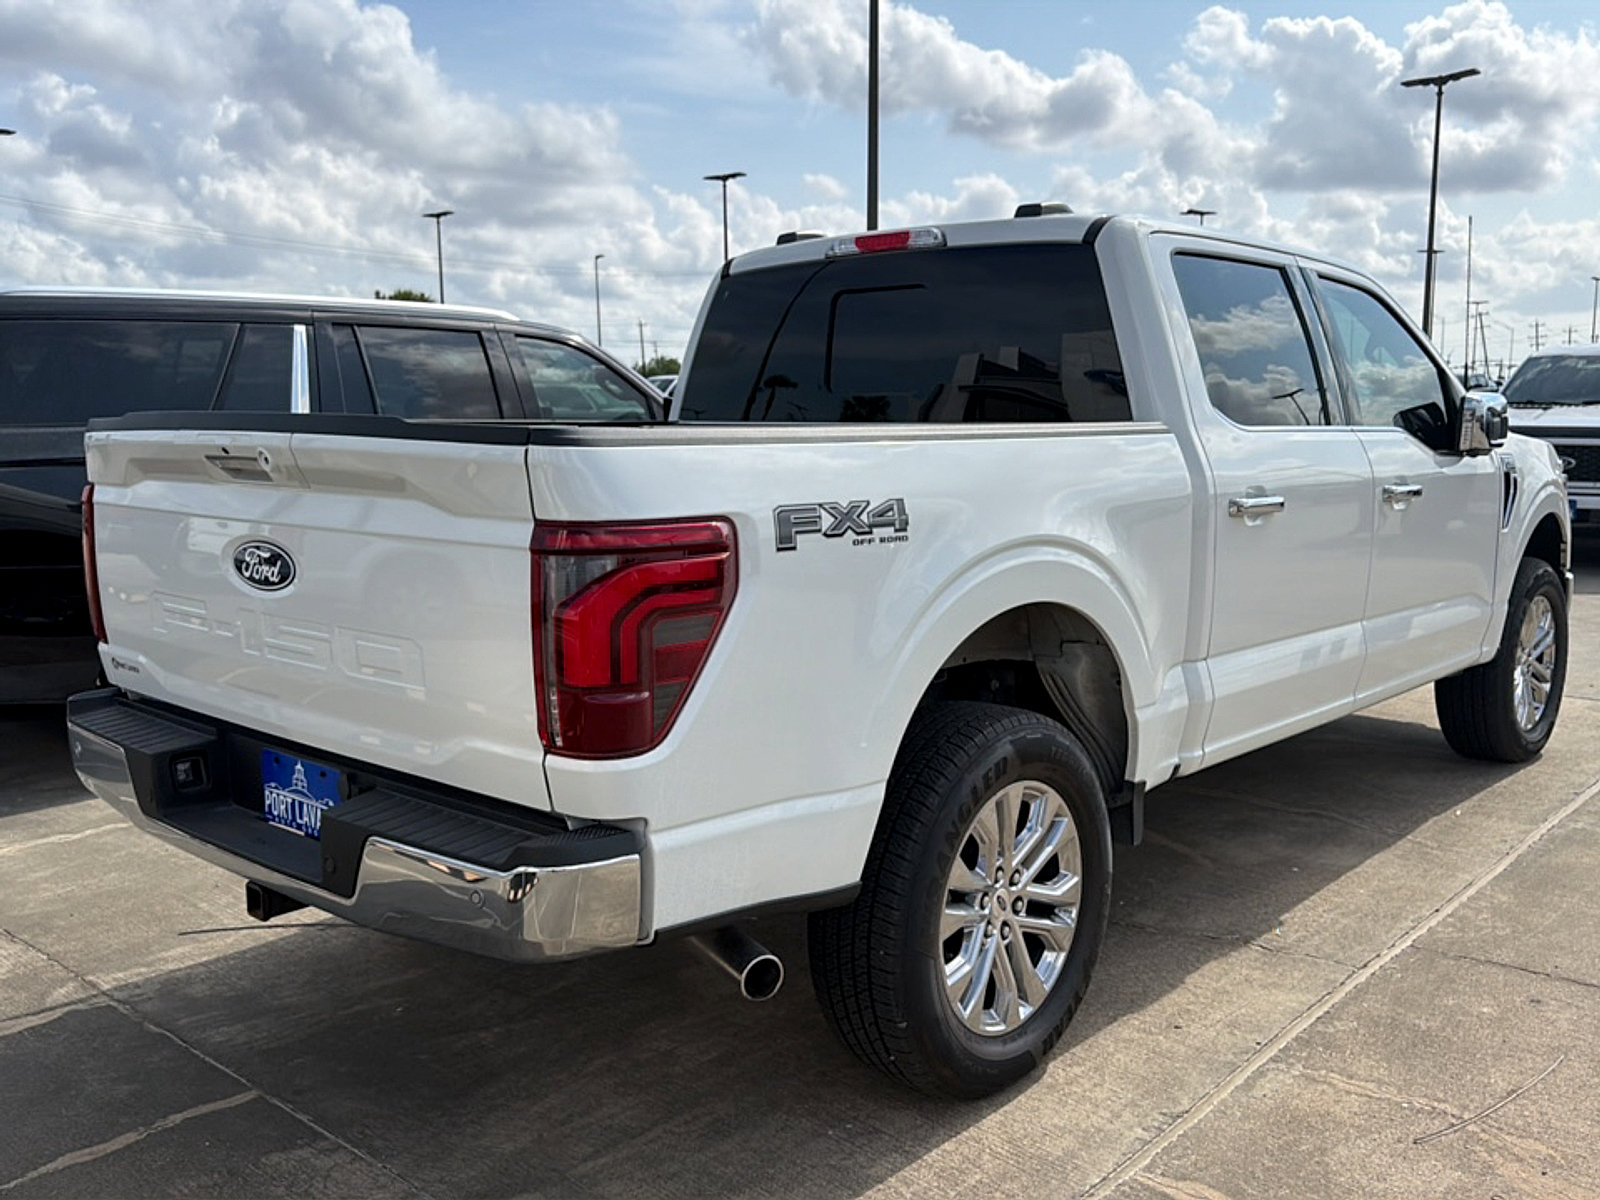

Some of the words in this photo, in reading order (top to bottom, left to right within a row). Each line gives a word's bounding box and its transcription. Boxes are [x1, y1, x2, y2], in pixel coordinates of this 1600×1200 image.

[773, 498, 909, 552] FX4
[852, 536, 875, 547] OFF
[879, 535, 908, 544] ROAD
[241, 548, 282, 584] Ford
[151, 590, 427, 691] F-150
[264, 790, 293, 821] PORT
